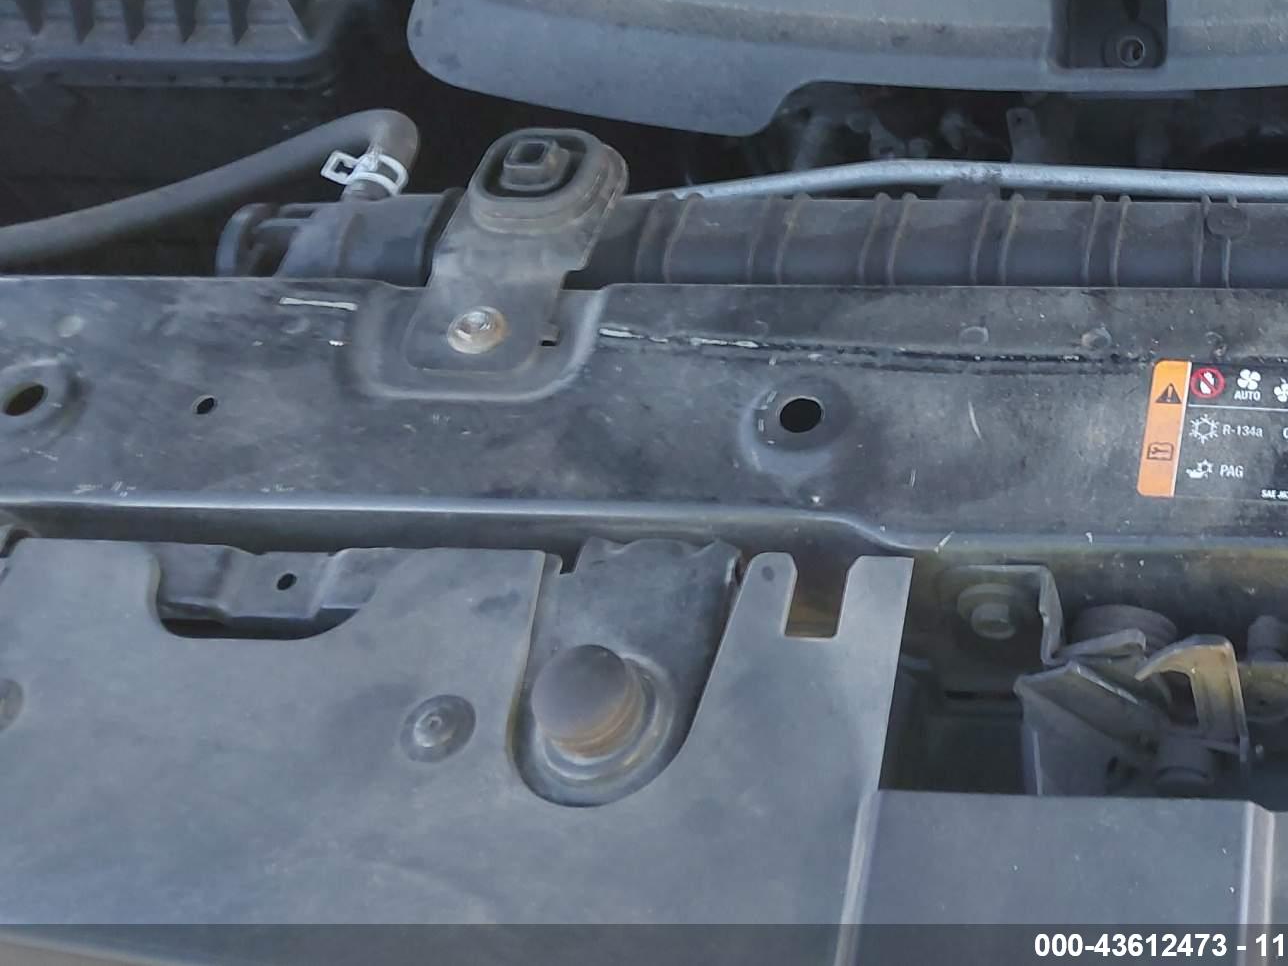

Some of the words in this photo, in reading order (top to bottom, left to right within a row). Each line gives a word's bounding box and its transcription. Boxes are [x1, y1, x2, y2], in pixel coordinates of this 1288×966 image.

[1233, 389, 1262, 402] AUTO
[1222, 424, 1264, 438] R-134a
[1219, 463, 1245, 478] PAG
[1261, 489, 1277, 500] SAE
